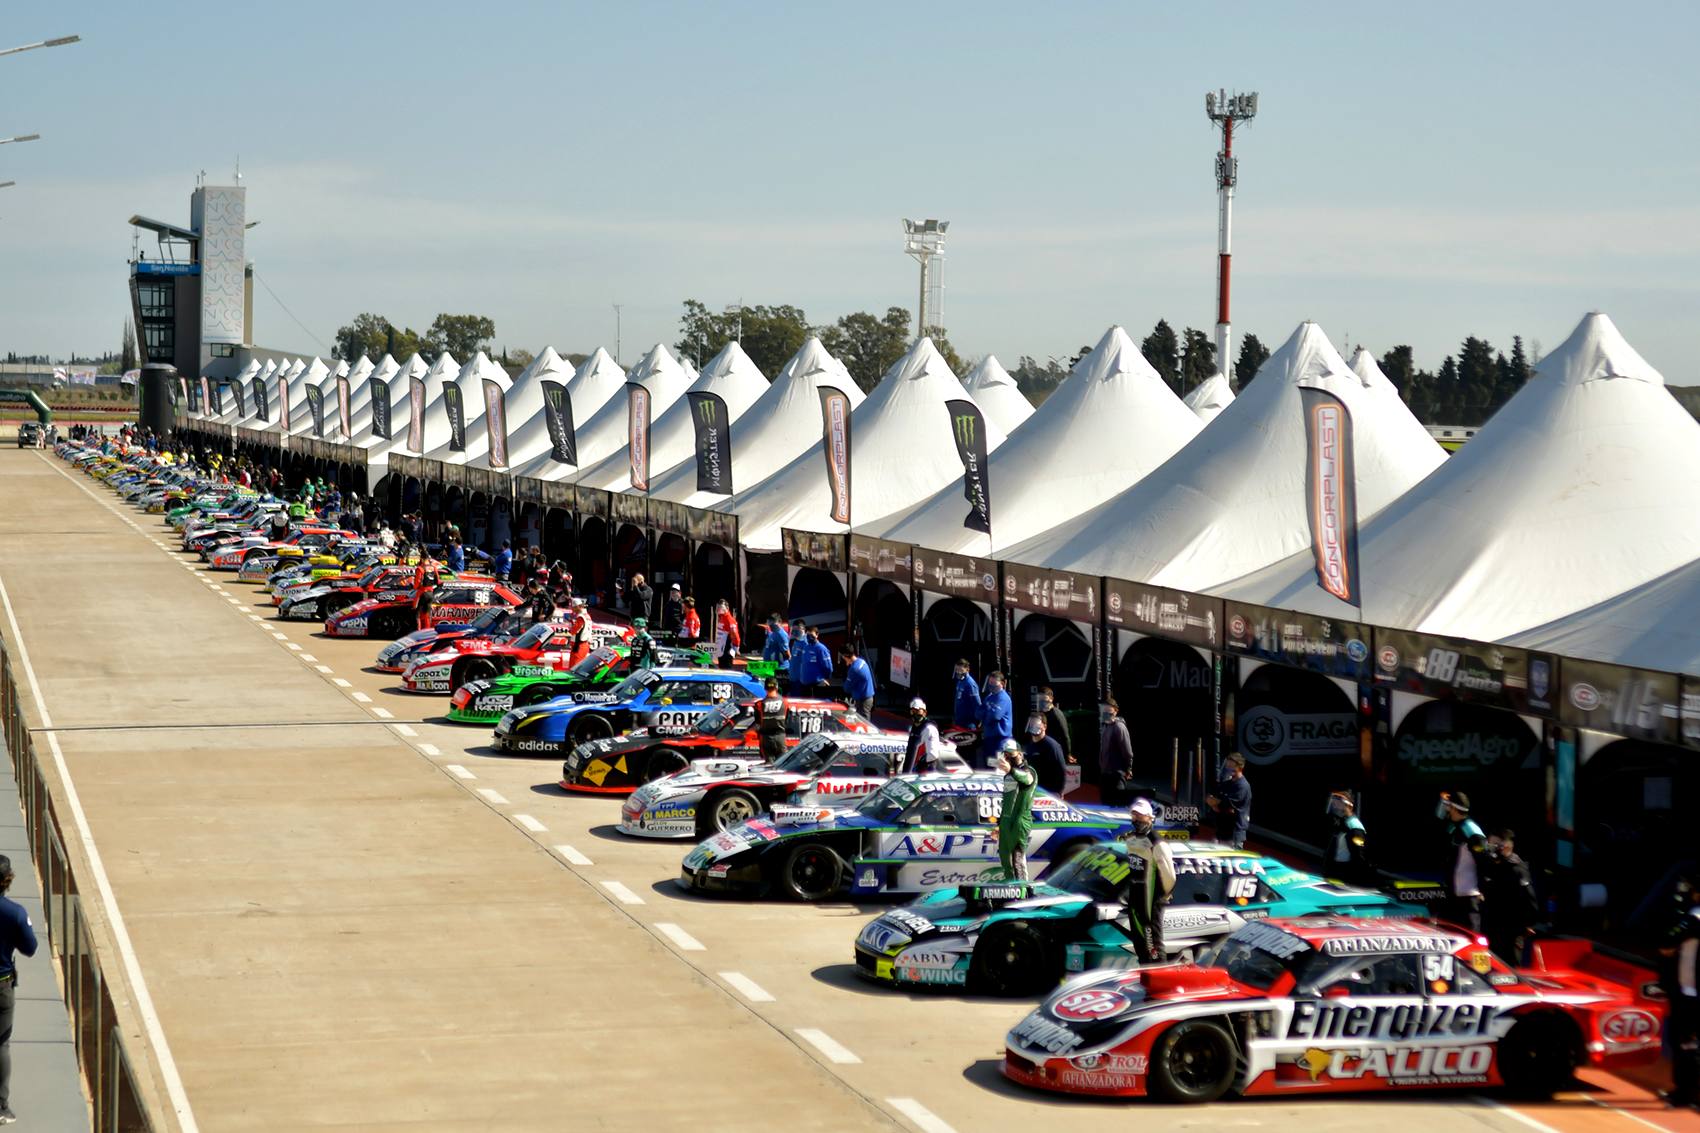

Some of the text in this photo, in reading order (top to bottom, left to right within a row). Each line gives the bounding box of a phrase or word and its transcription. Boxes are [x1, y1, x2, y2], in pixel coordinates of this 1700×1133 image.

[474, 590, 490, 604] 96
[712, 684, 732, 699] 33
[800, 717, 822, 733] 118
[518, 740, 560, 751] adidas
[655, 807, 696, 820] MARCO
[982, 886, 1022, 899] ARMANDO
[1226, 877, 1258, 899] 115
[1423, 955, 1455, 982] 54
[1286, 999, 1500, 1042] Energizer
[1608, 1013, 1651, 1037] STP
[1328, 1044, 1493, 1080] CALICO
